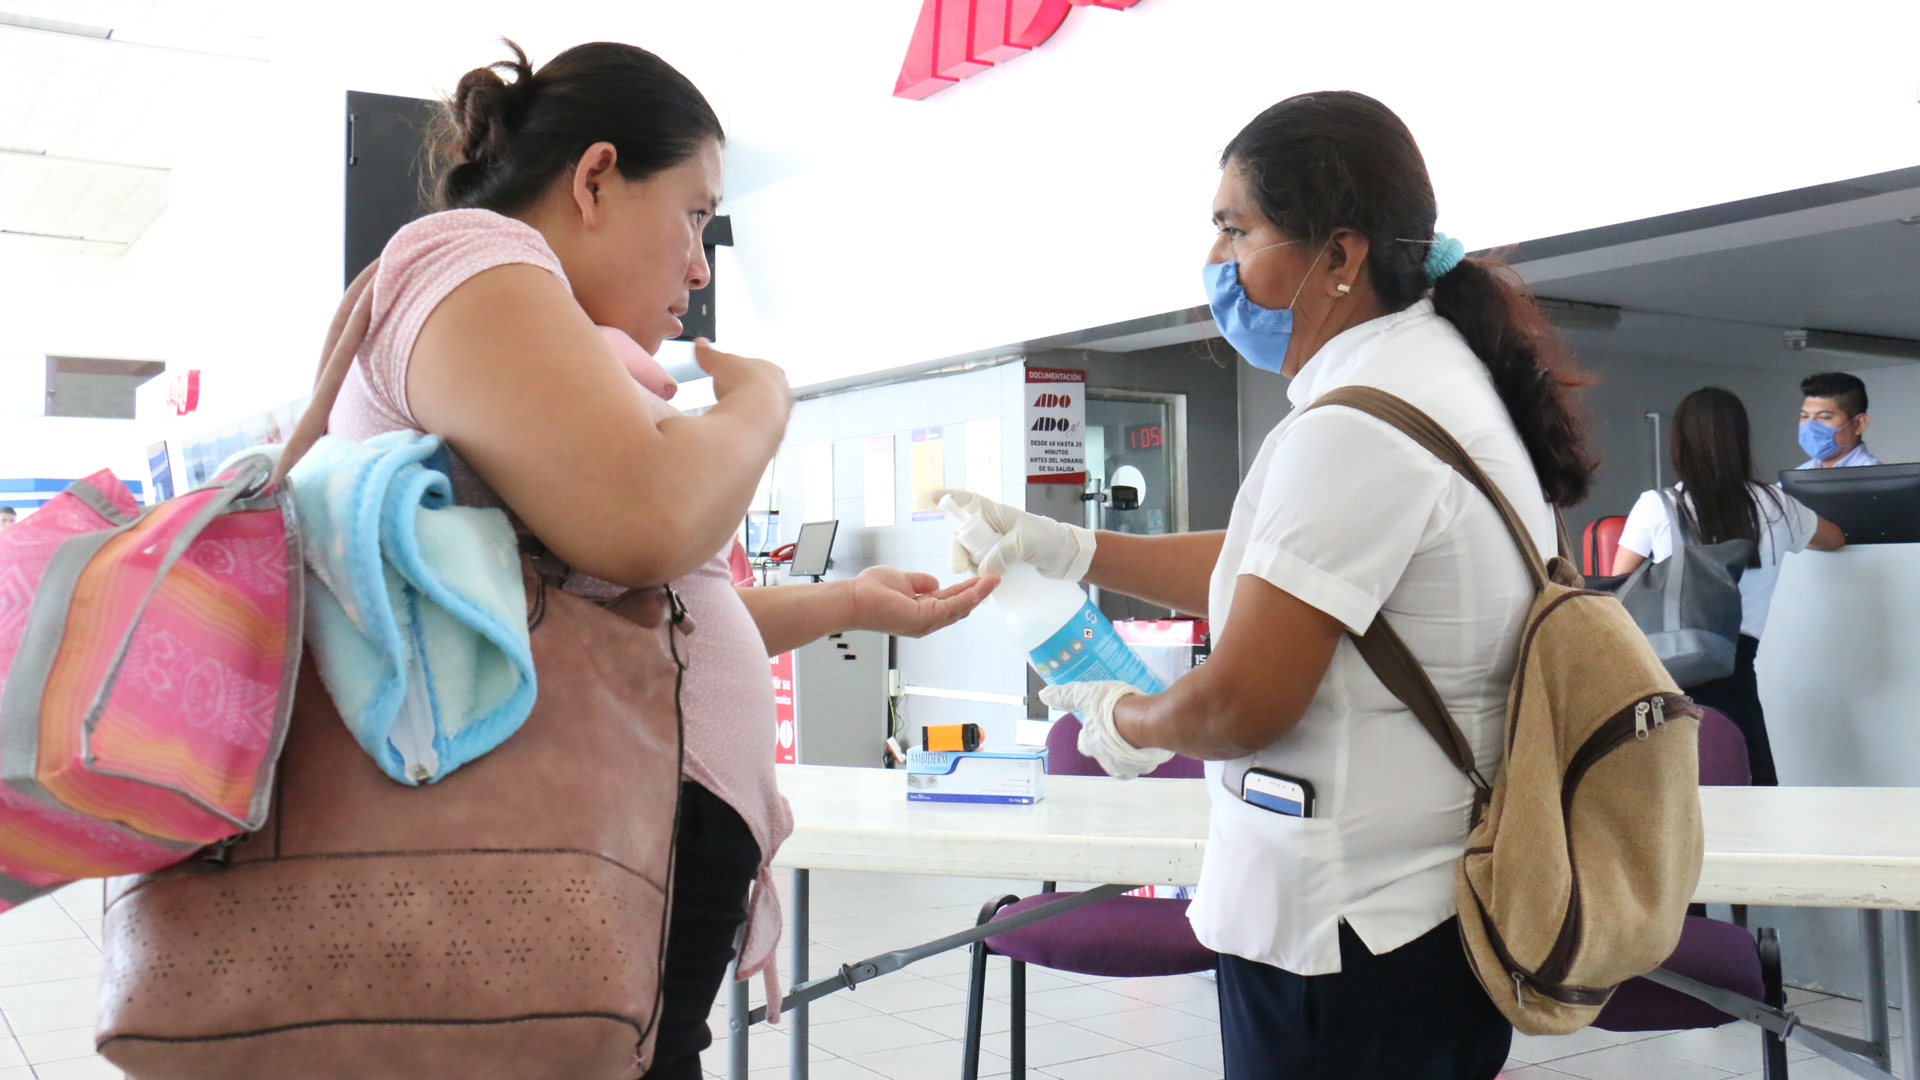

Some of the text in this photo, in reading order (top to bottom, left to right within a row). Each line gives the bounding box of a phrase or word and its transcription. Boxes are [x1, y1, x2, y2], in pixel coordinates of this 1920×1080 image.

[1029, 371, 1082, 381] DOCUMENTACIÓN
[1033, 394, 1071, 408] ADO
[1031, 416, 1070, 432] ADO
[910, 752, 948, 765] AMBIDERM
